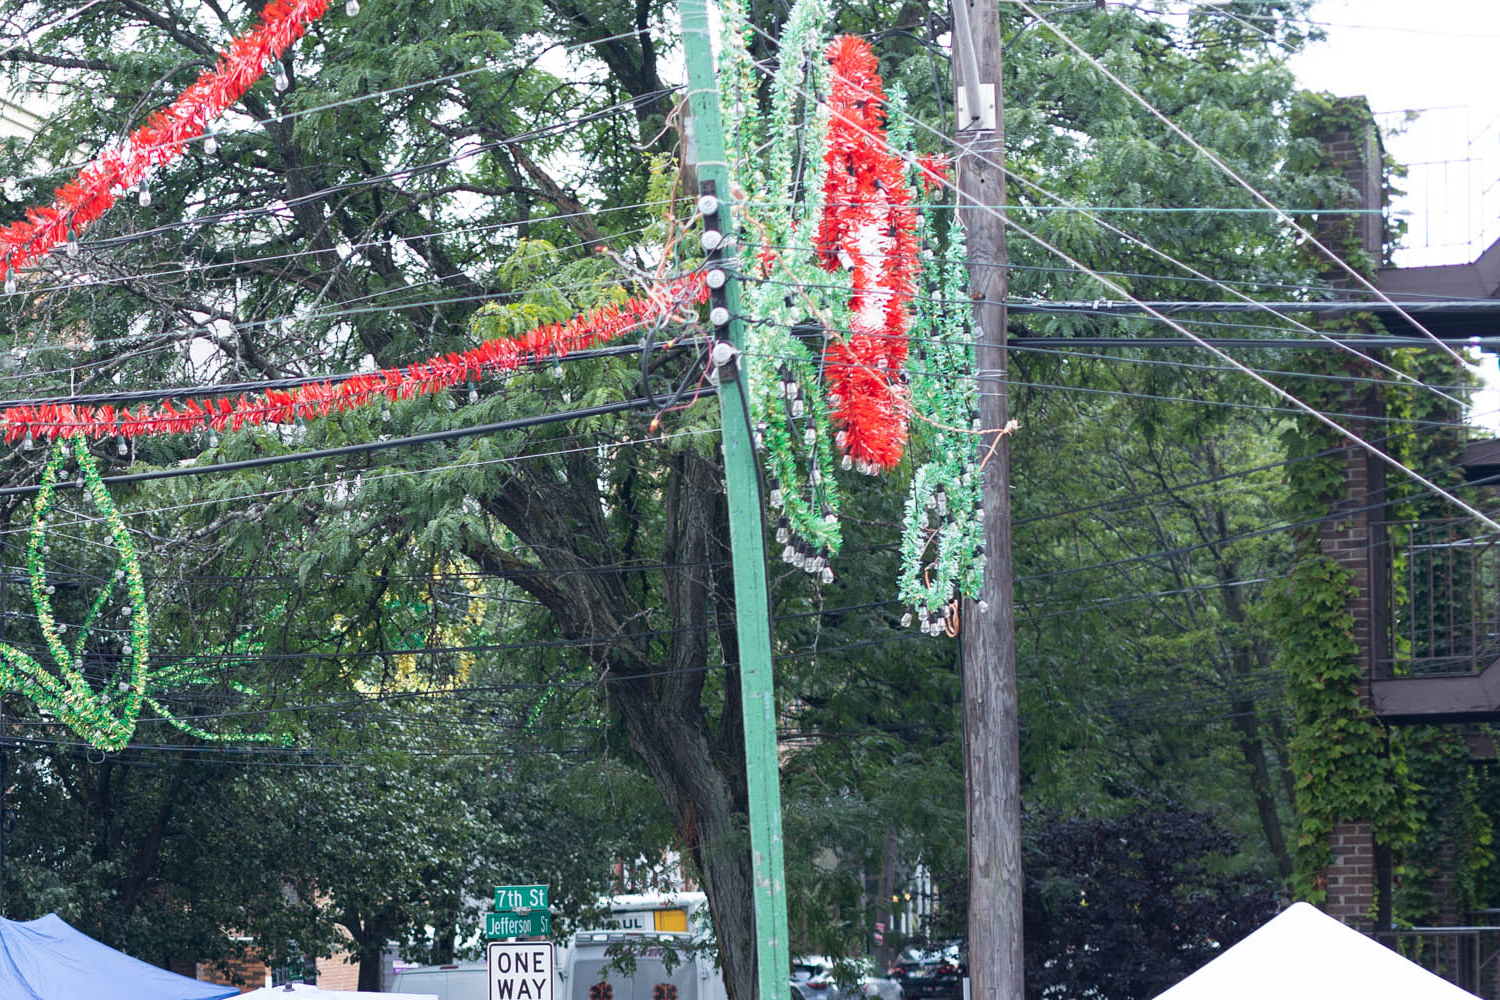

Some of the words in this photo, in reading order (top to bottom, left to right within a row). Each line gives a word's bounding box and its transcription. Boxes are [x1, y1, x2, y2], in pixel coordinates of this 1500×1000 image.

[497, 889, 522, 908] 7th
[530, 888, 545, 906] St
[489, 917, 531, 936] Jefferson
[497, 952, 545, 974] ONE
[497, 978, 547, 1000] WAY
